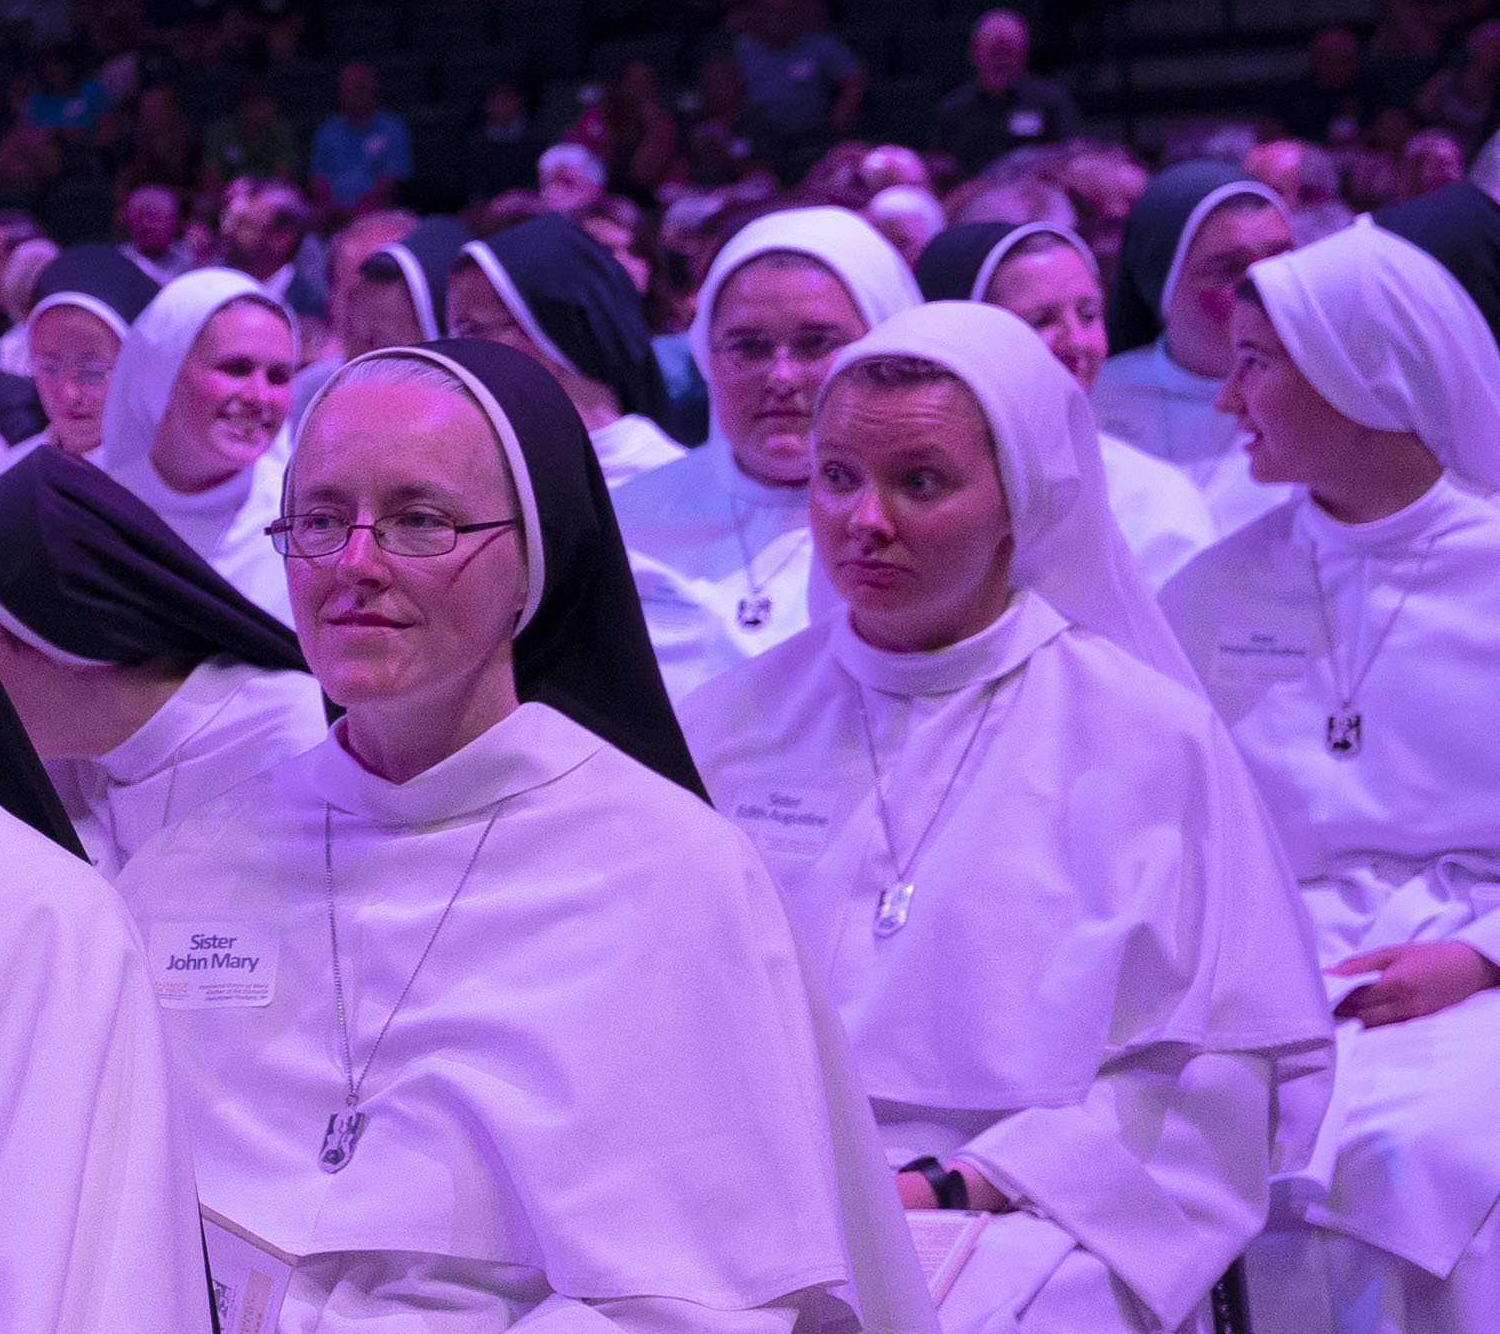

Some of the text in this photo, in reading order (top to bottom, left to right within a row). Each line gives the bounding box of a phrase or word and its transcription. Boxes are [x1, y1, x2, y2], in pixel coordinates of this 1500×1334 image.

[190, 933, 238, 950] Sister
[166, 953, 260, 973] John Mary
